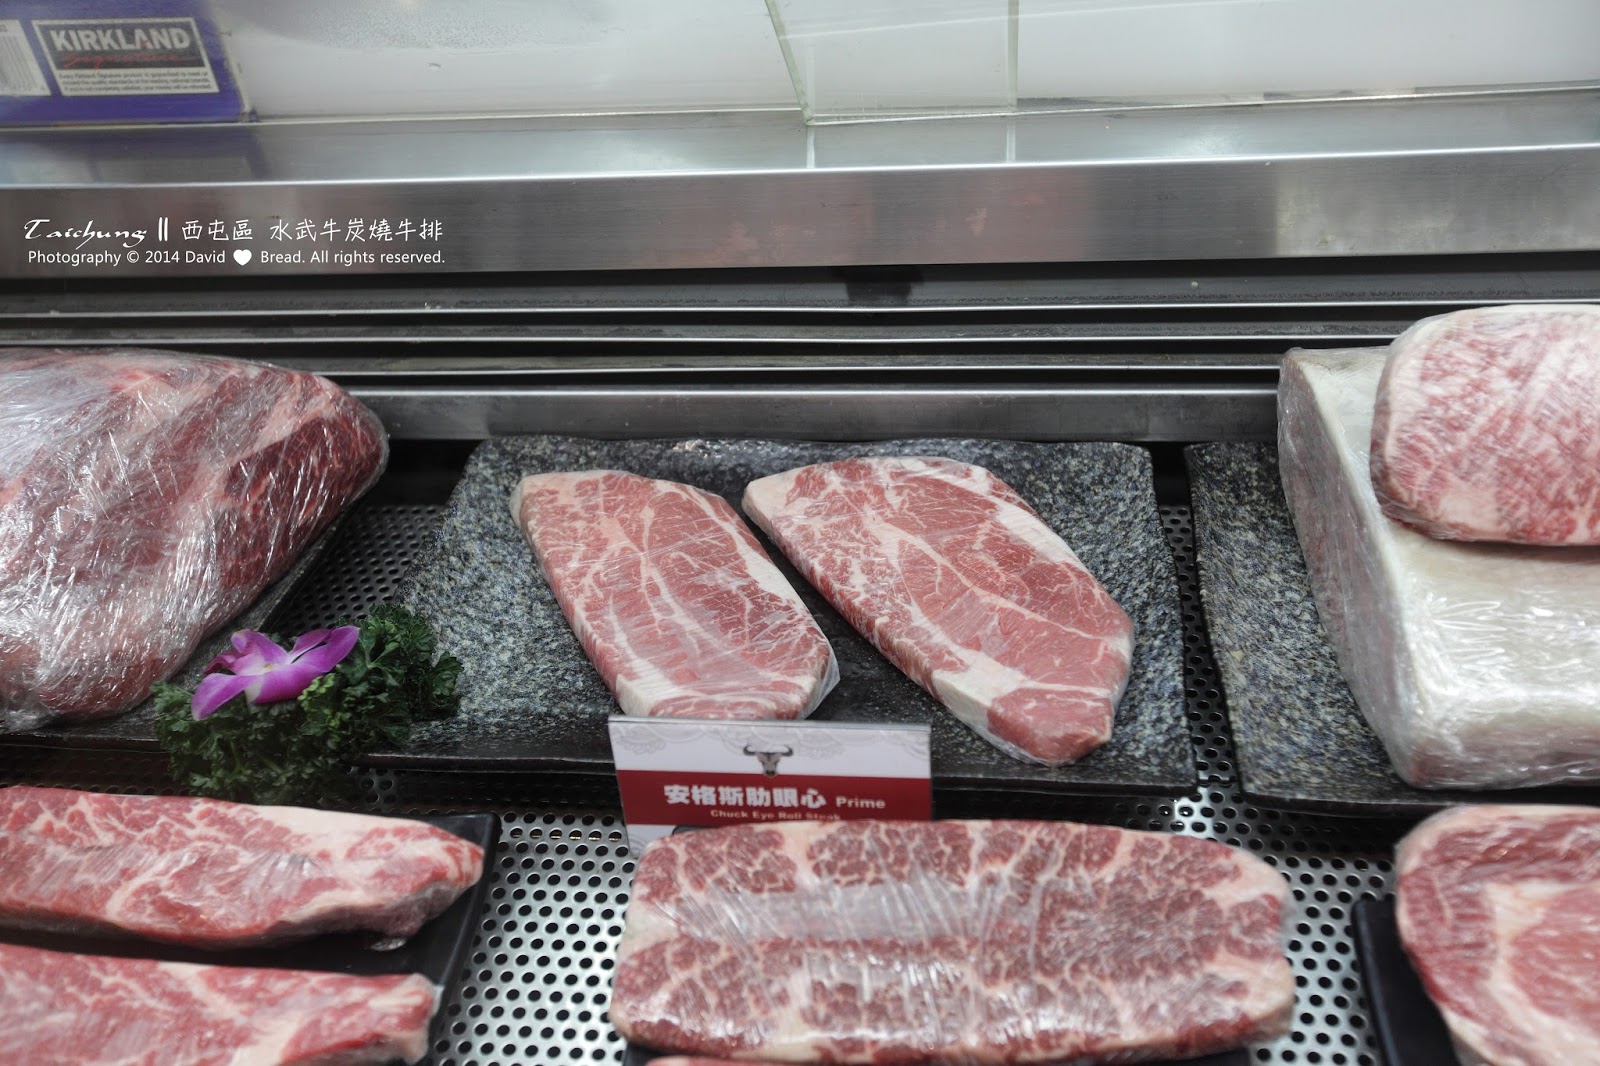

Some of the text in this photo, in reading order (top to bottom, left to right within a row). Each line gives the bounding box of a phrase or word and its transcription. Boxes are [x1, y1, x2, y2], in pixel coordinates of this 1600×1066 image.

[50, 28, 190, 51] KIRKLAND
[664, 785, 886, 809] 安格斯肋眼心 Prime
[710, 809, 749, 819] Chuck
[752, 810, 775, 820] Eye
[778, 811, 802, 820] Roll
